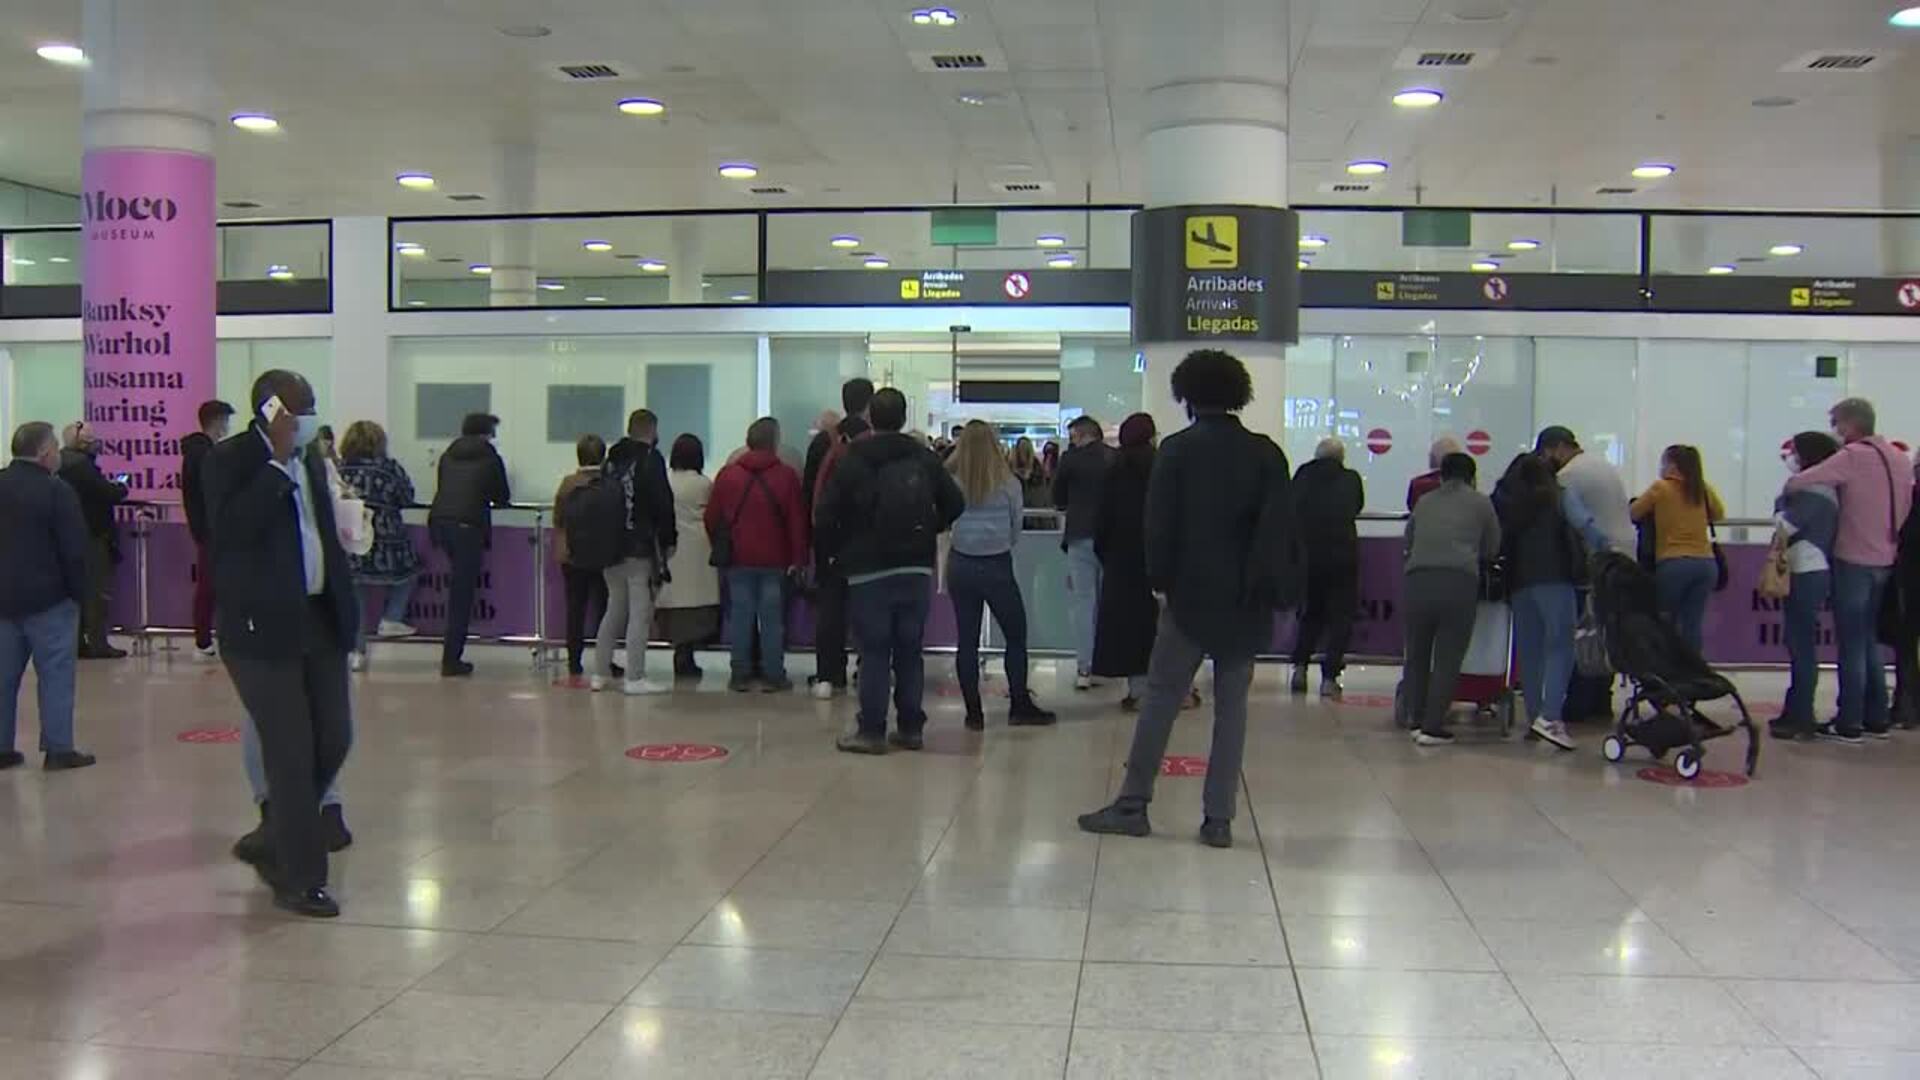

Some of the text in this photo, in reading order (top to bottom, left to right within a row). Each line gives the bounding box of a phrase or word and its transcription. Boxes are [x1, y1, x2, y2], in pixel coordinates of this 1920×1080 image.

[84, 190, 177, 222] Moco
[1187, 275, 1264, 292] Arribades
[84, 297, 172, 327] Banksy
[1186, 297, 1239, 311] Arrivals
[1187, 315, 1259, 335] Llegadas
[84, 331, 171, 356] Warhol
